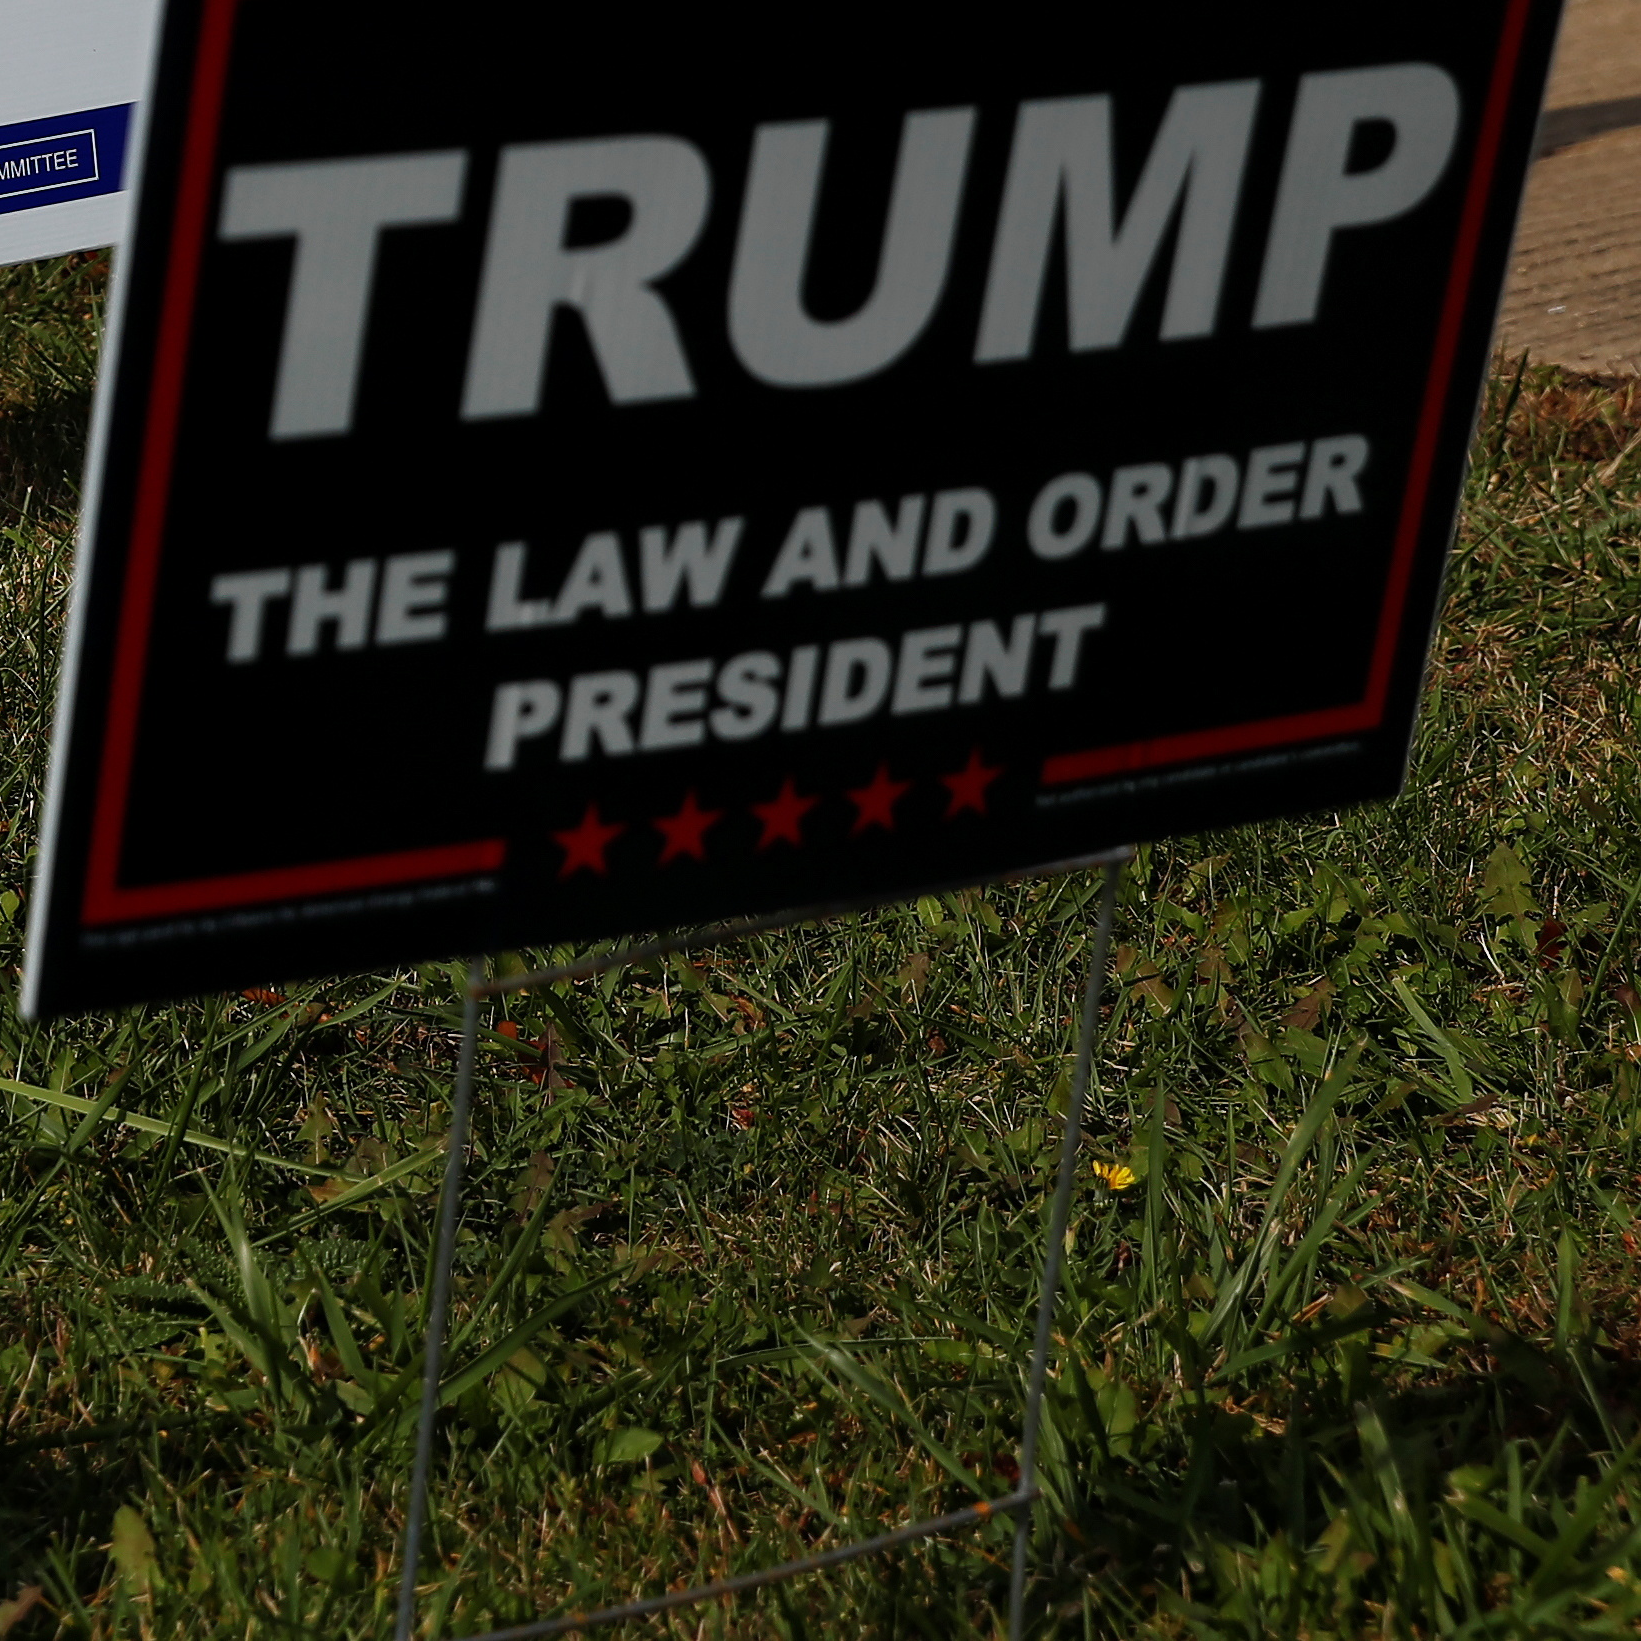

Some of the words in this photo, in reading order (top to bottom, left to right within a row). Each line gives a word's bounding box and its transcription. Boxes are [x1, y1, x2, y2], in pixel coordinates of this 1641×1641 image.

[218, 60, 1463, 442] TRUMP
[210, 550, 456, 664] THE
[485, 516, 743, 632] LAW
[762, 484, 997, 597] AND
[1025, 433, 1370, 558] ORDER
[484, 604, 1106, 770] PRESIDENT
